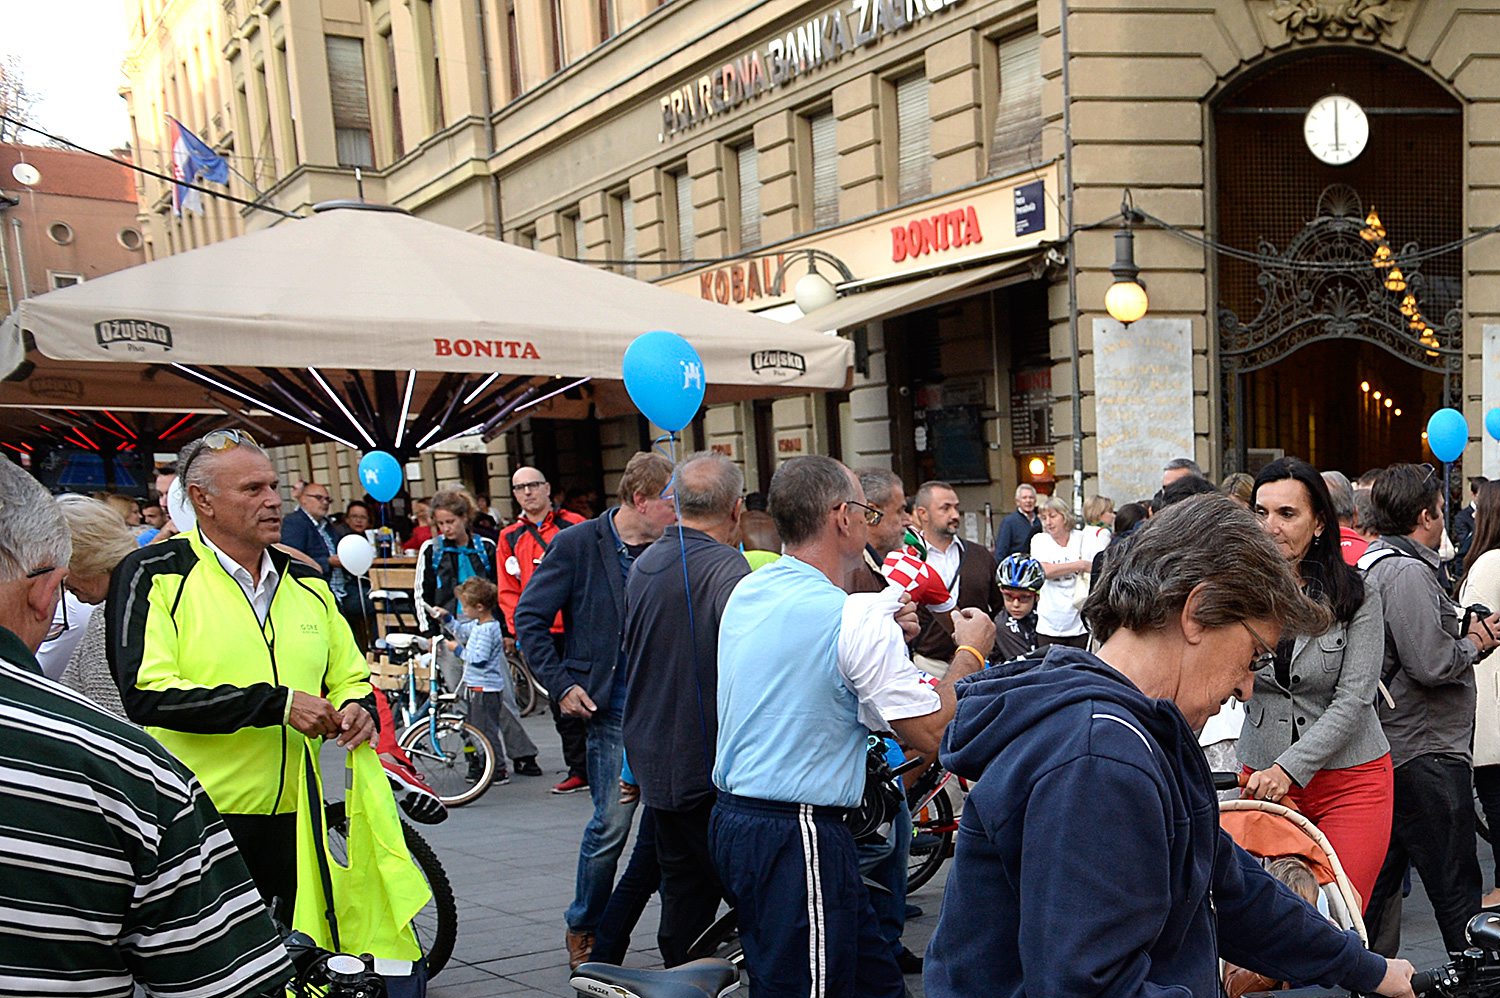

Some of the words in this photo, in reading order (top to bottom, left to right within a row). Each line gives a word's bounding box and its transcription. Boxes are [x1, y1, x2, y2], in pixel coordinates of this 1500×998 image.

[768, 9, 851, 81] BANKA
[891, 206, 983, 263] BONITA
[101, 319, 168, 343] Ožujsko
[434, 338, 541, 360] BONITA
